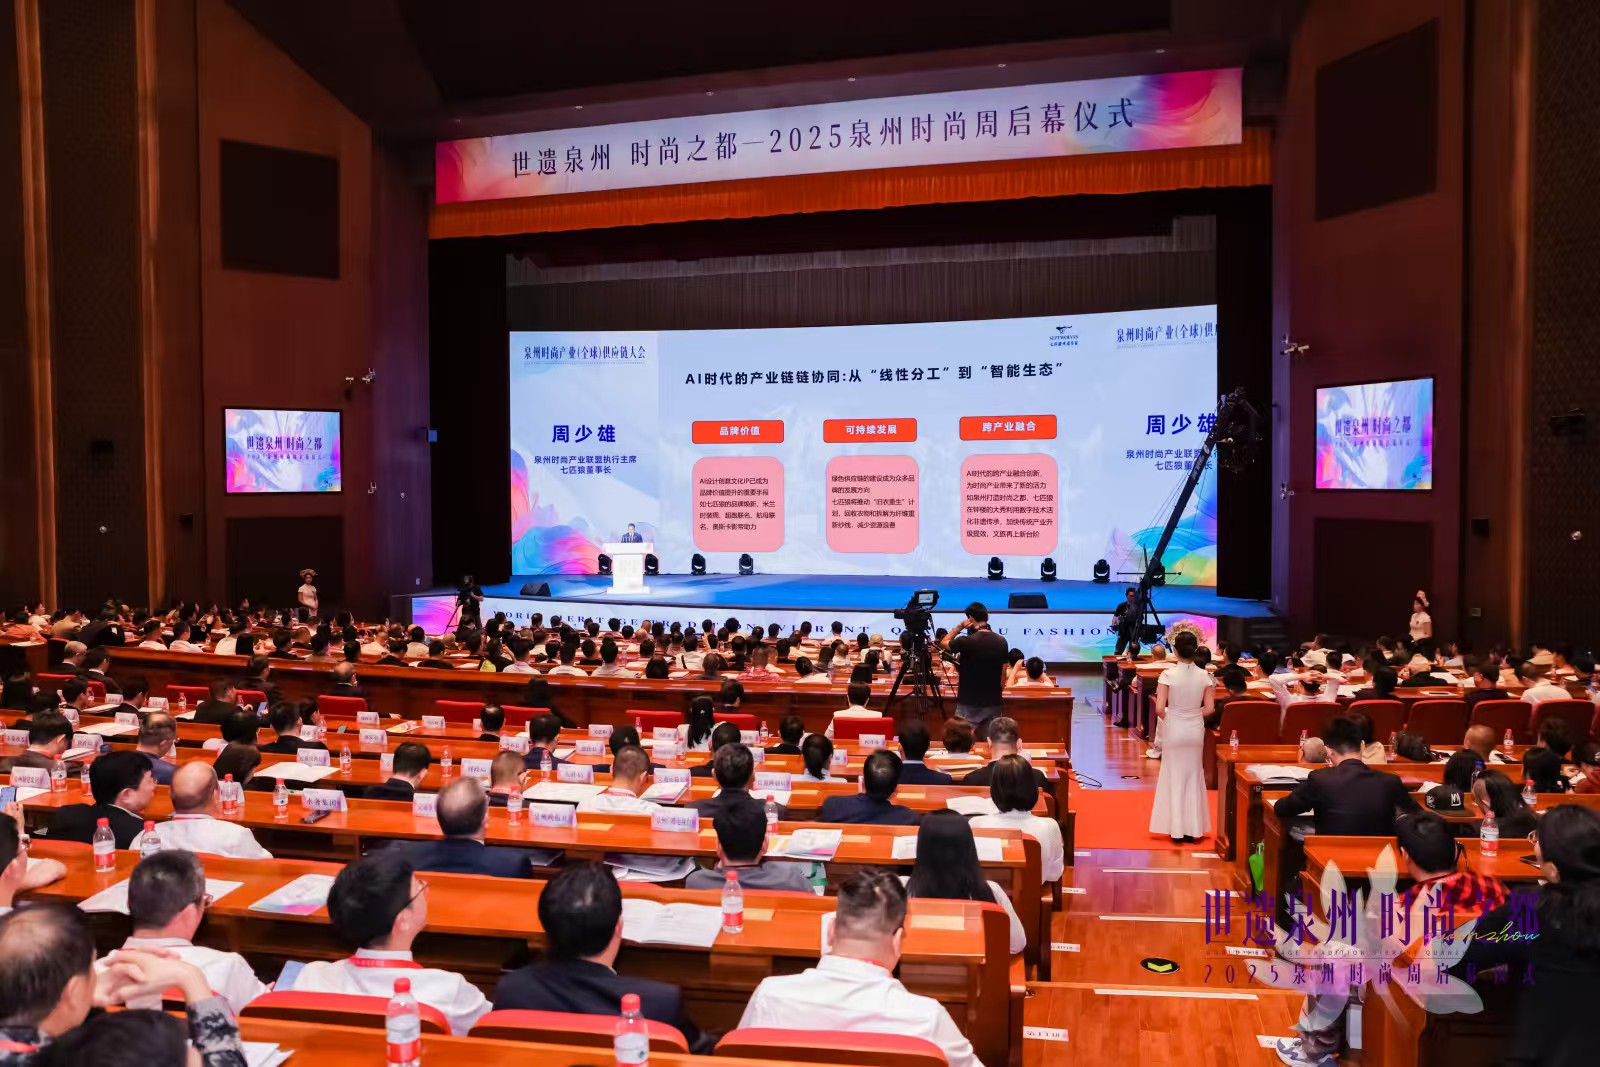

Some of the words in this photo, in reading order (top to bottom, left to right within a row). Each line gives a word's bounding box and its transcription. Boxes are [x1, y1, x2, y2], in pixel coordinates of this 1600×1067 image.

[512, 148, 612, 179] 世遗泉州
[1117, 322, 1217, 342] 泉州时尚产业(全球)供
[524, 345, 646, 360] 泉州时尚产业(全球)供应链大会
[845, 424, 898, 435] 可持续发展
[981, 421, 1037, 432] 跨产业融合
[1145, 413, 1217, 435] 周少雄
[552, 425, 616, 443] 周少雄
[719, 425, 761, 437] 品牌价值
[534, 455, 637, 464] 泉州时尚产业联盟执行主席
[560, 465, 612, 475] 七匹狼董事长
[1154, 461, 1213, 471] 七匹狼董长
[778, 625, 869, 634] VIRNT
[1023, 627, 1117, 636] FASHION
